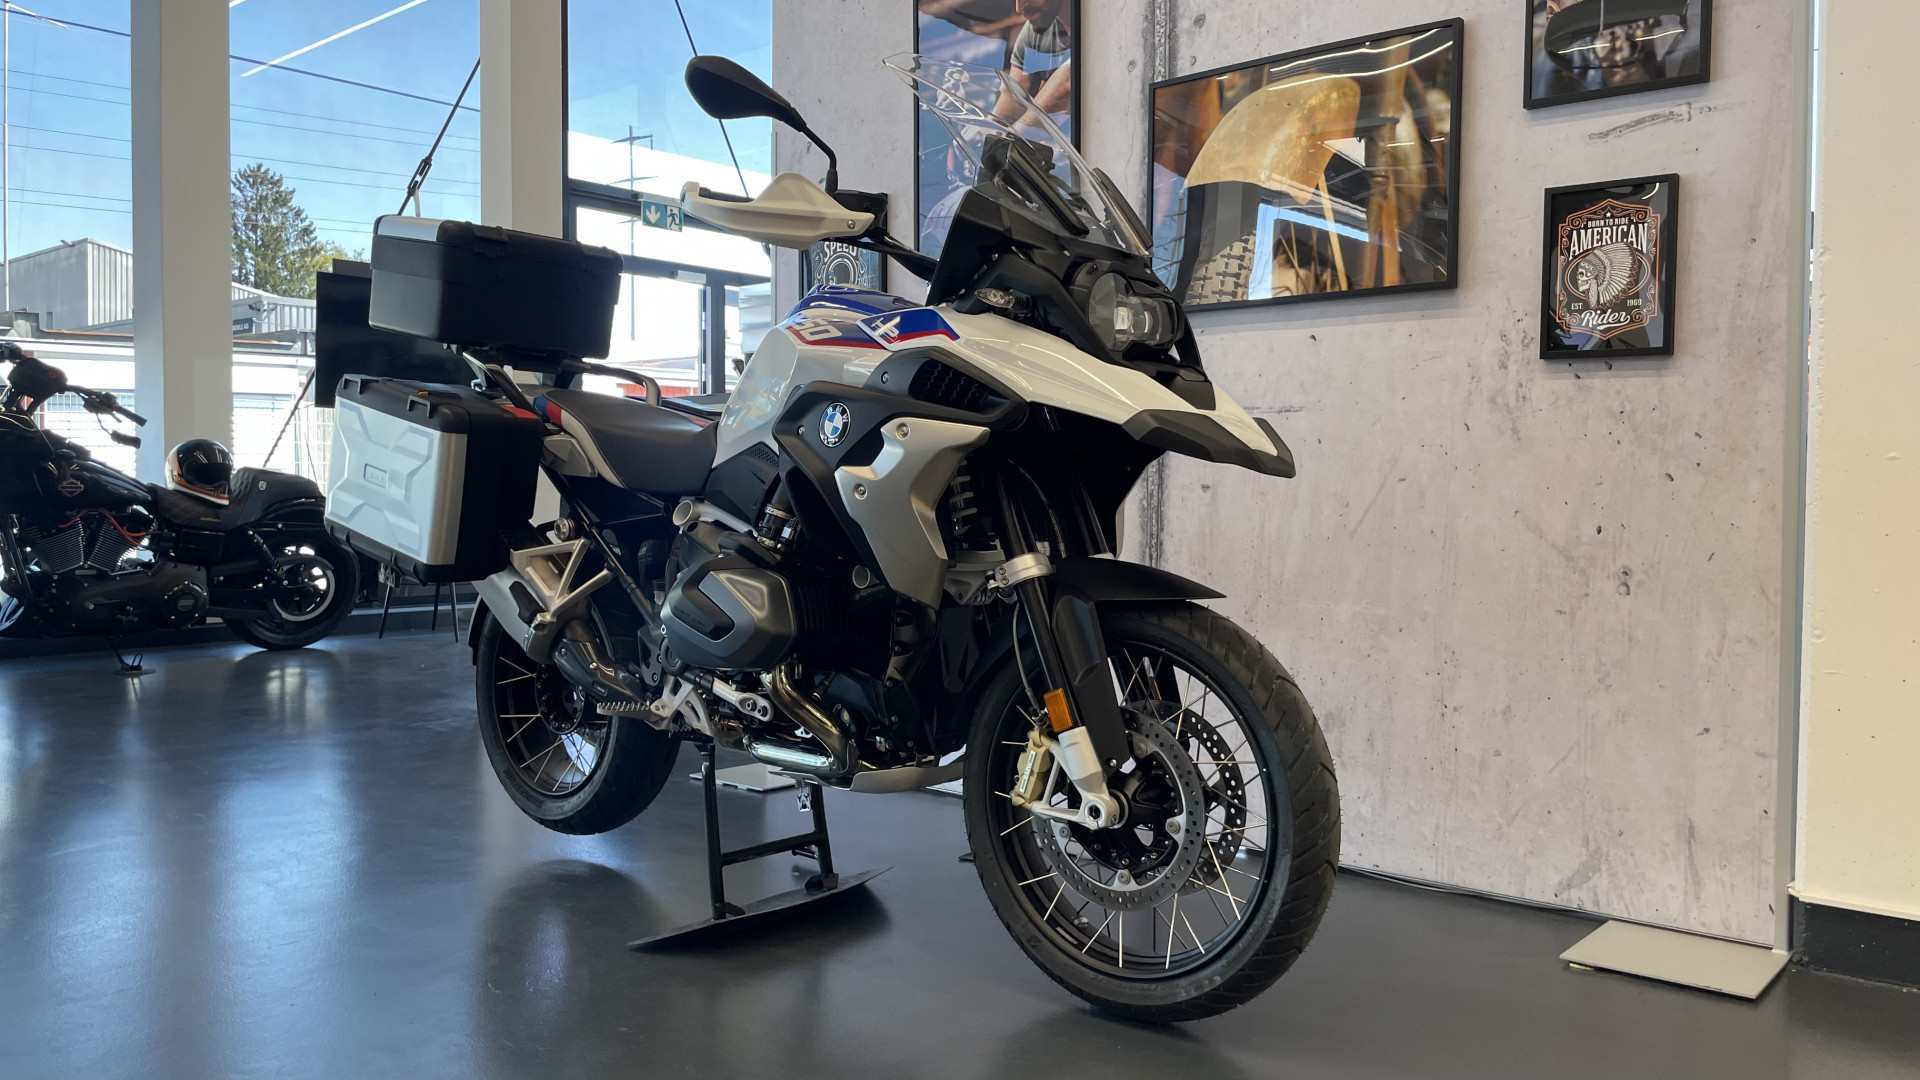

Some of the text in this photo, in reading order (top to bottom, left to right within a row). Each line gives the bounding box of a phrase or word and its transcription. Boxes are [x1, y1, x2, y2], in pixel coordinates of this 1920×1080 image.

[1587, 217, 1629, 228] BORN TO RIDE
[1569, 223, 1648, 261] AMERICAN
[1581, 309, 1630, 330] Rider
[826, 405, 849, 423] BMW
